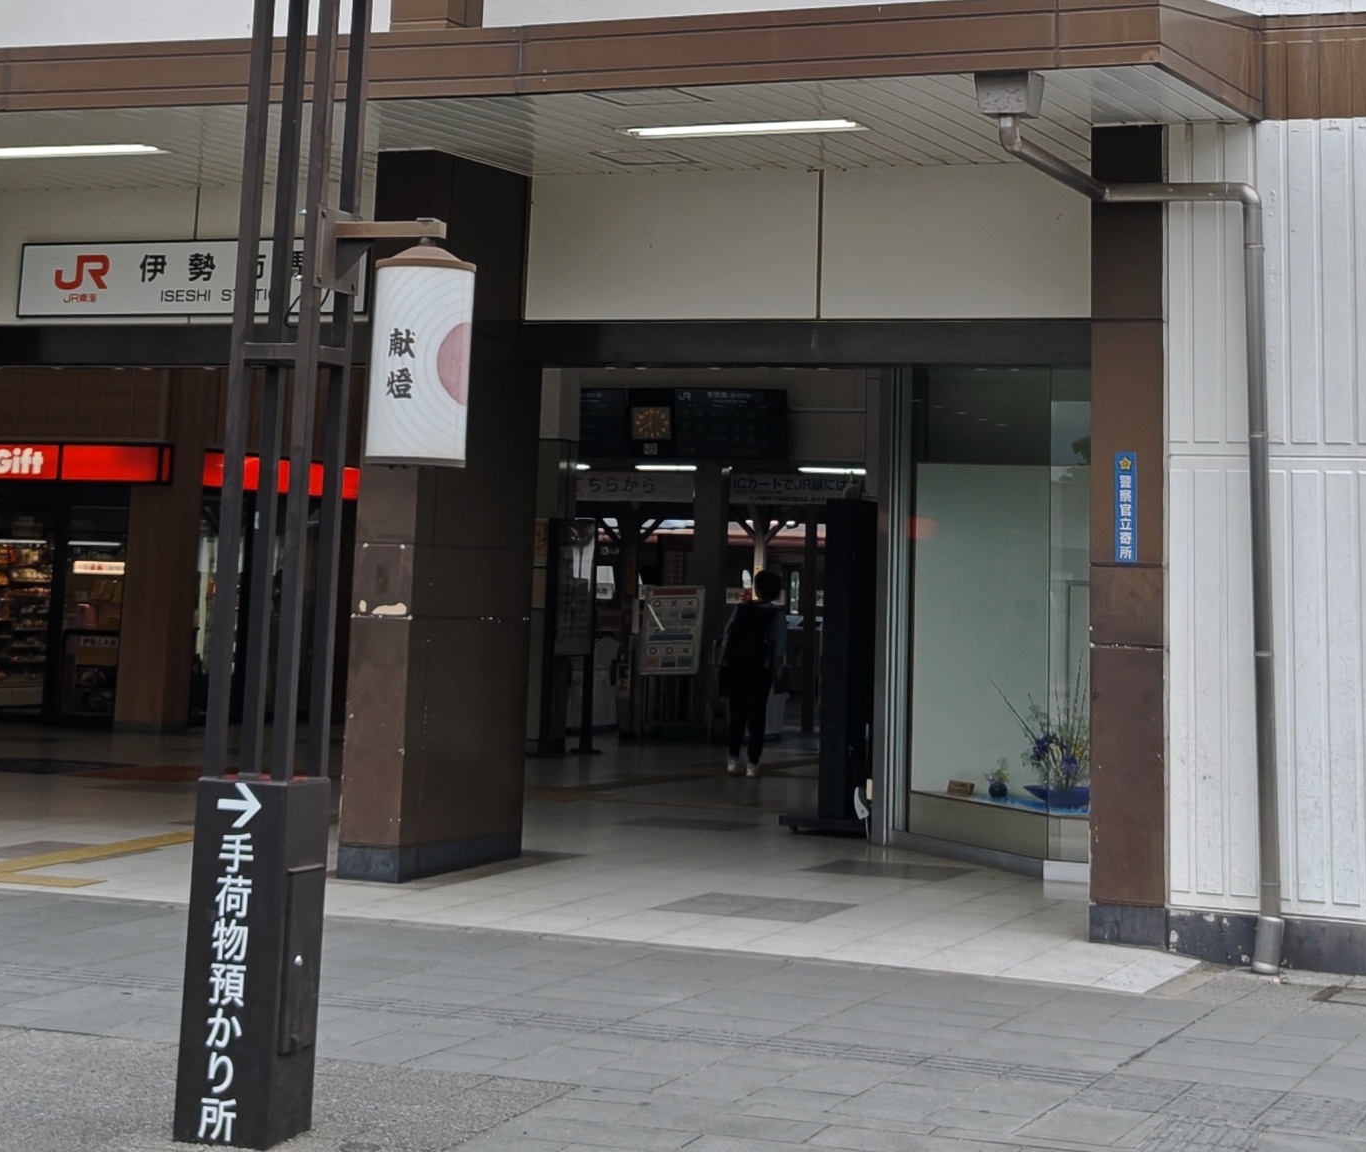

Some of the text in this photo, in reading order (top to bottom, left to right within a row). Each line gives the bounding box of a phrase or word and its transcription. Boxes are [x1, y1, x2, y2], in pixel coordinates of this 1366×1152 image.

[54, 254, 110, 290] JR
[160, 290, 212, 303] ISESHI
[577, 476, 655, 493] ちらから
[1119, 474, 1133, 560] 警察官立寄所
[197, 832, 254, 1142] 手荷物預かり所
